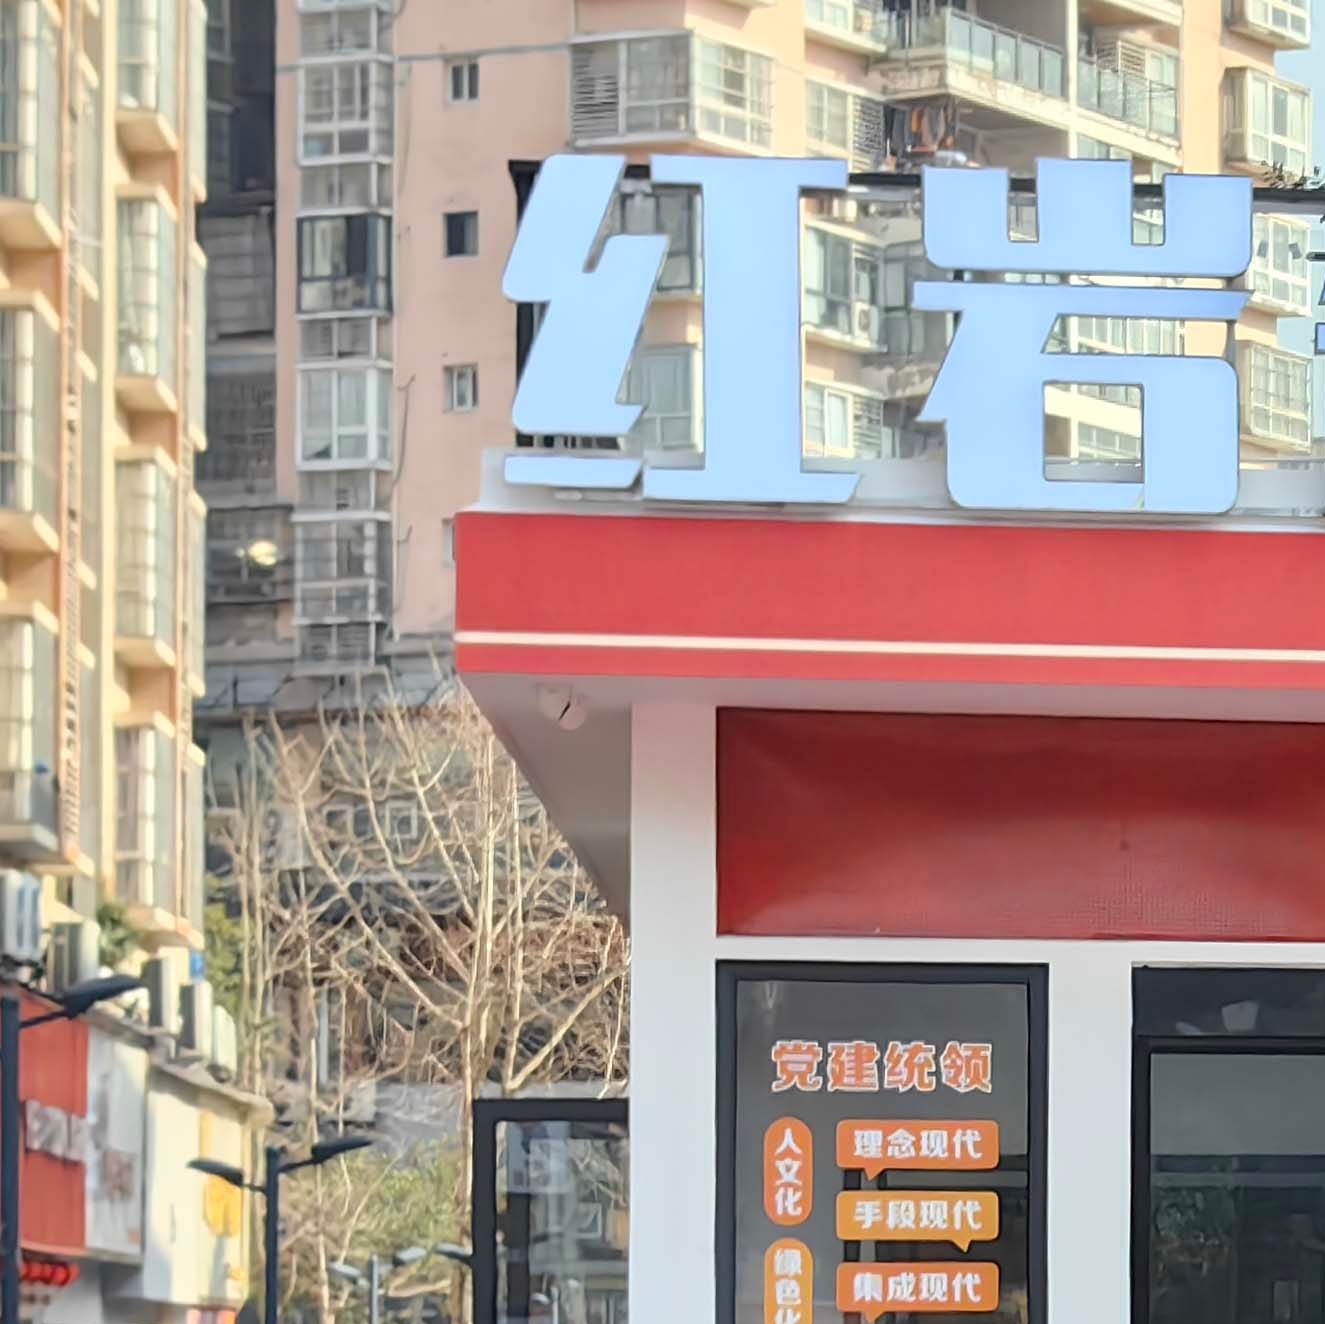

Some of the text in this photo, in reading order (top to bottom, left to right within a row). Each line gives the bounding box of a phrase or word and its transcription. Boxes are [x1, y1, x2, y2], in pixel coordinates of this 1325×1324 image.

[771, 1040, 993, 1094] 党建统领
[853, 1129, 983, 1160] 理念现代
[774, 1128, 803, 1218] 人文化
[853, 1200, 983, 1231] 手段现代
[853, 1272, 983, 1303] 集成现代
